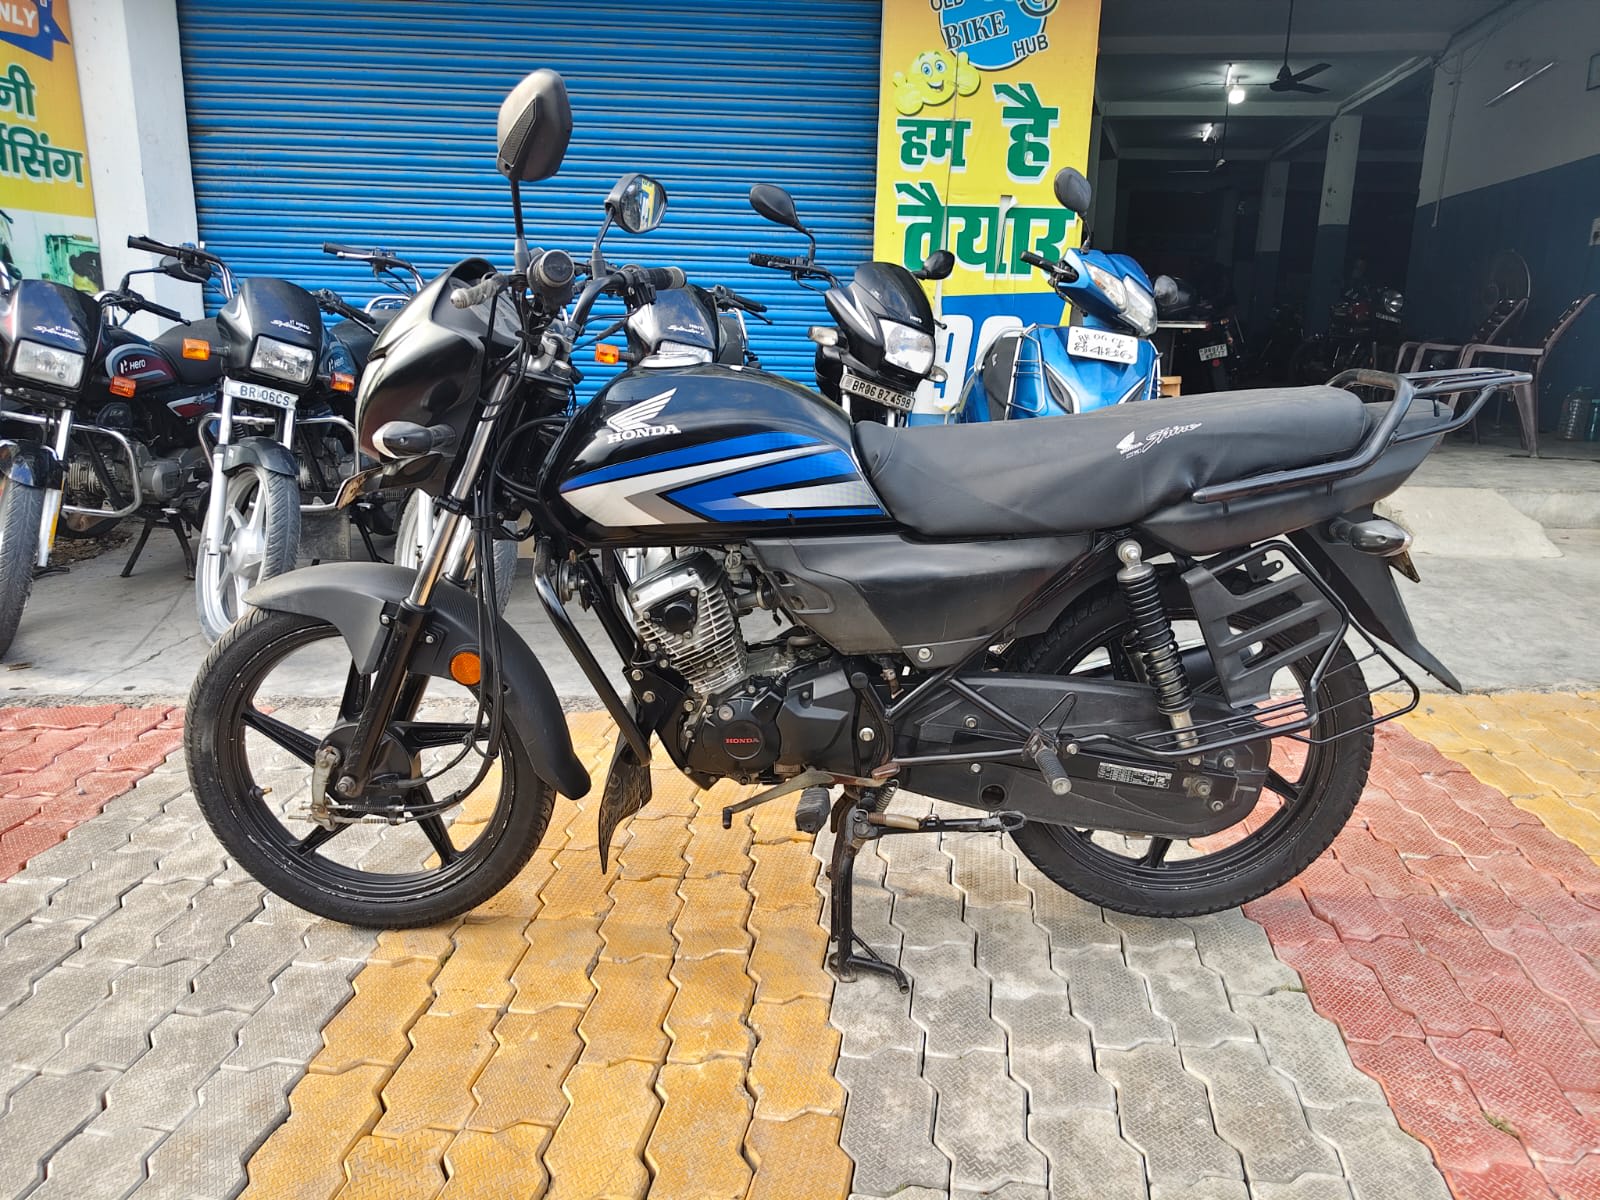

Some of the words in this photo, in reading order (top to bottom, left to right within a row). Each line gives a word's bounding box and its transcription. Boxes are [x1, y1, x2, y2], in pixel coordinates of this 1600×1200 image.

[943, 11, 1008, 50] BIKE
[1013, 35, 1049, 58] HUB
[897, 118, 972, 168] हम
[993, 83, 1060, 177] है
[129, 359, 146, 371] Hero
[607, 424, 681, 445] HONDA
[725, 737, 760, 745] HONDA
